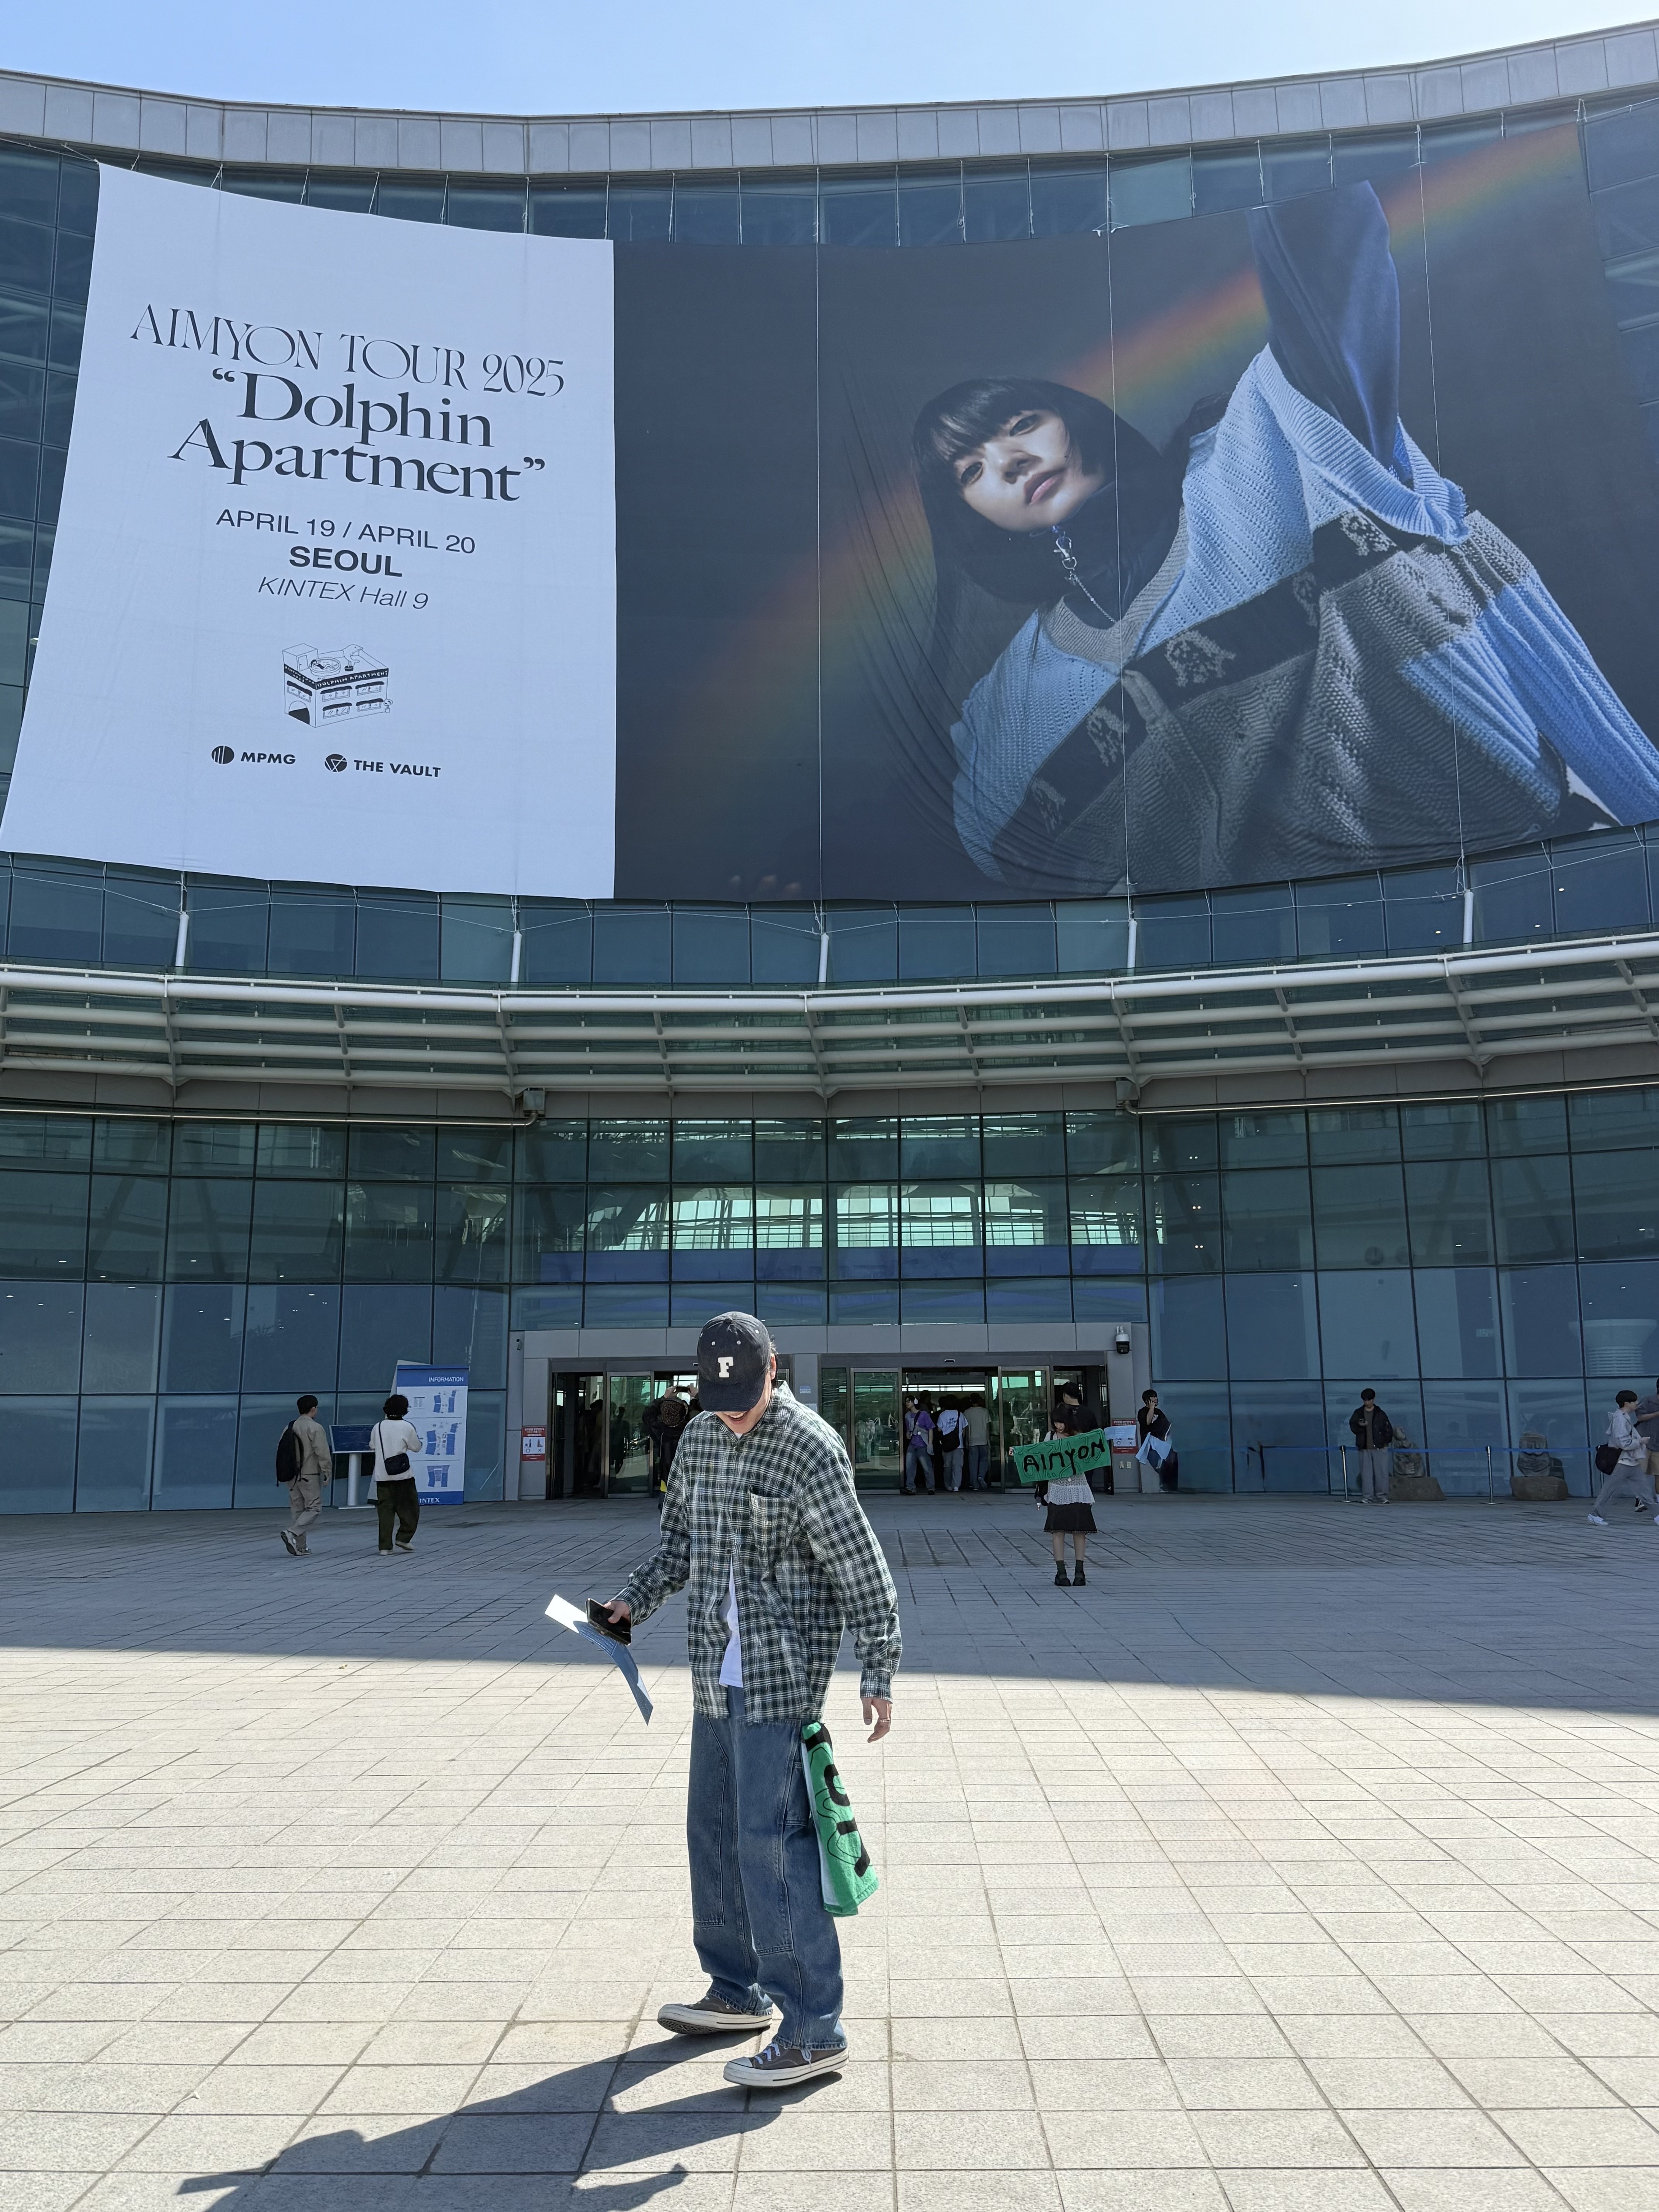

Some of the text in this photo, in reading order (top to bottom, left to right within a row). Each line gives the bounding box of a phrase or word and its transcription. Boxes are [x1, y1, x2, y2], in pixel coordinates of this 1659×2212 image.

[130, 304, 564, 397] AIMYON TOUR 2025
[212, 368, 495, 447] “Dolphin
[167, 418, 545, 501] Apartment”
[216, 509, 476, 554] APRIL 19 / APRIL 20
[289, 546, 403, 577] SEOUL
[258, 577, 429, 609] KINTEX Hall 9
[317, 678, 347, 687] DOLPHIN
[350, 670, 388, 681] APARTMENT
[240, 752, 296, 764] MPMG
[353, 759, 441, 778] THE VAULT
[718, 1357, 734, 1378] F
